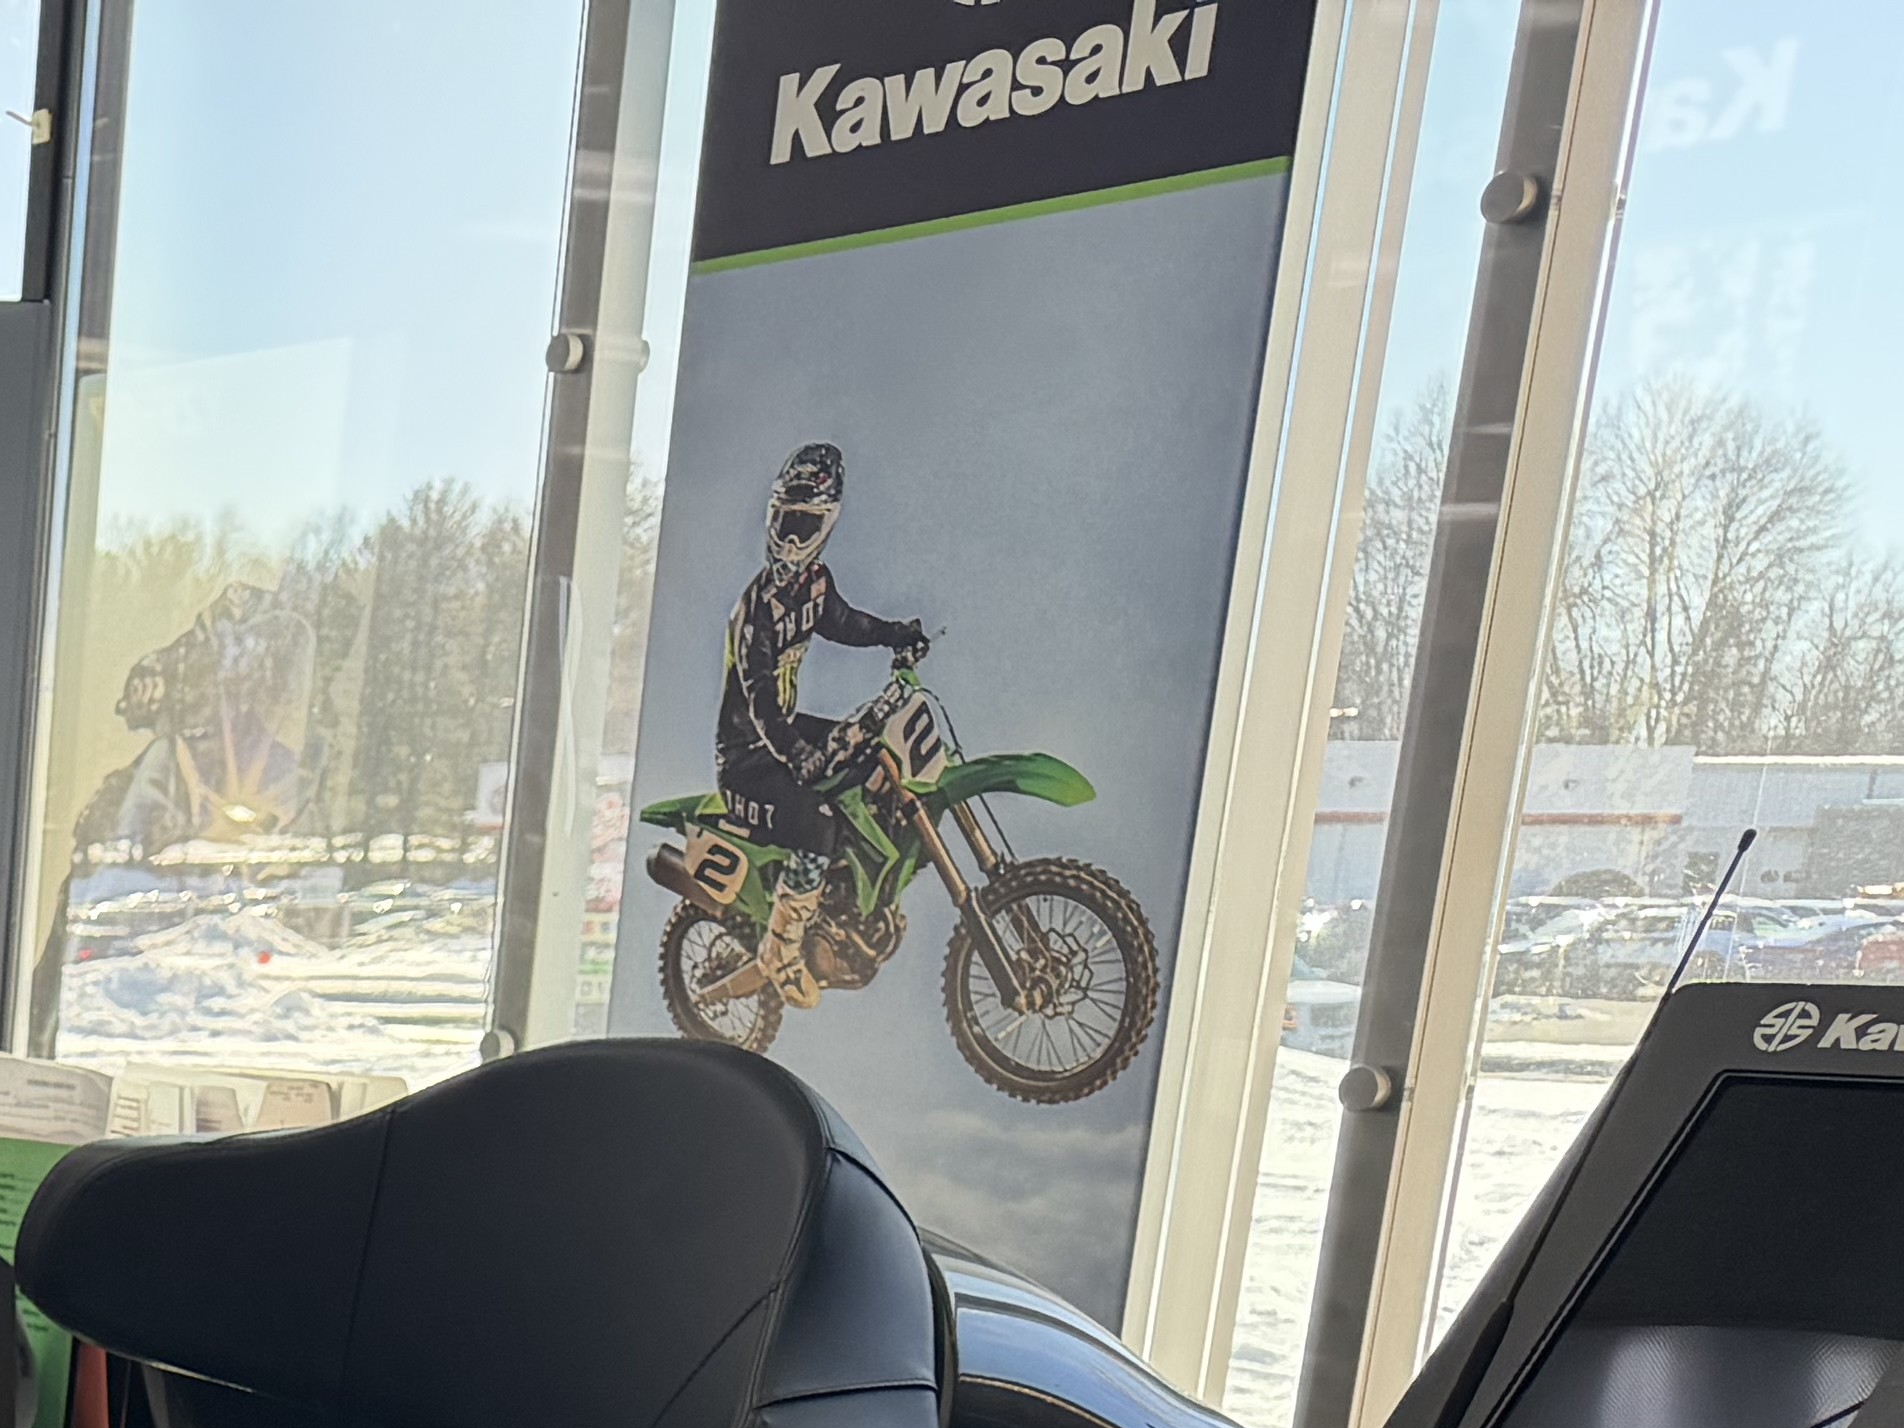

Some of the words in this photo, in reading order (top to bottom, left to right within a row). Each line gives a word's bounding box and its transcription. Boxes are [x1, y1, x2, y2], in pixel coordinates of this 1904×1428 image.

[770, 0, 1218, 166] Kawasaki
[903, 700, 943, 778] 2
[694, 844, 741, 894] 2
[1817, 1012, 1904, 1051] Ka
